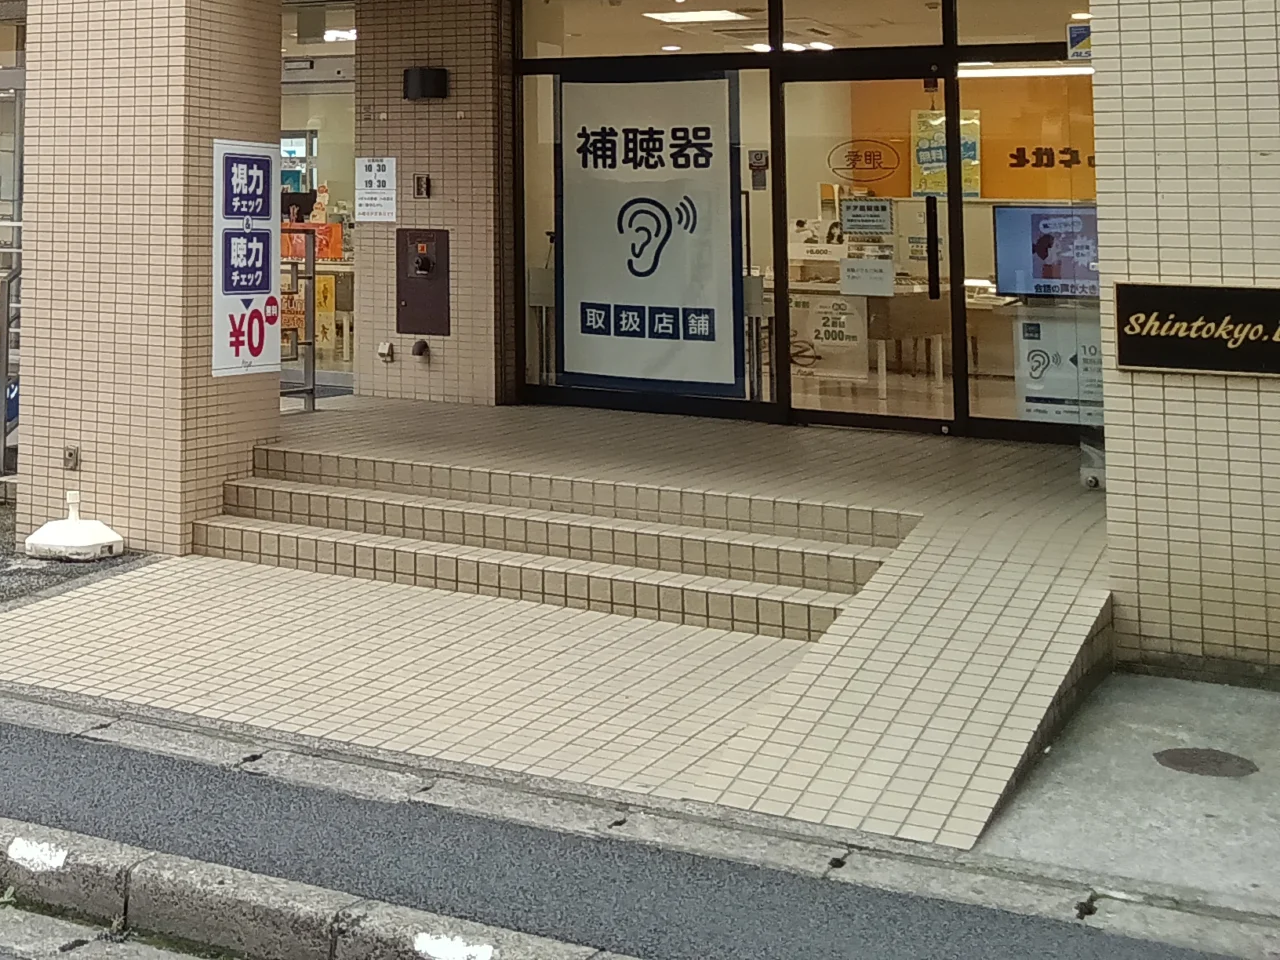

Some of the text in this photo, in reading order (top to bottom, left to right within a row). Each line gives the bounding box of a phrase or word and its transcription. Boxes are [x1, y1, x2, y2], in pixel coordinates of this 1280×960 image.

[575, 125, 714, 171] 補聴器
[844, 150, 884, 170] 愛眼
[231, 163, 265, 195] 視力
[231, 196, 263, 213] チェック
[244, 216, 253, 230] &
[231, 236, 264, 268] 聴力
[231, 270, 263, 287] チェック
[228, 308, 265, 358] ¥0
[584, 307, 711, 337] 取扱店舗
[1124, 311, 1280, 349] Shintokyo.
